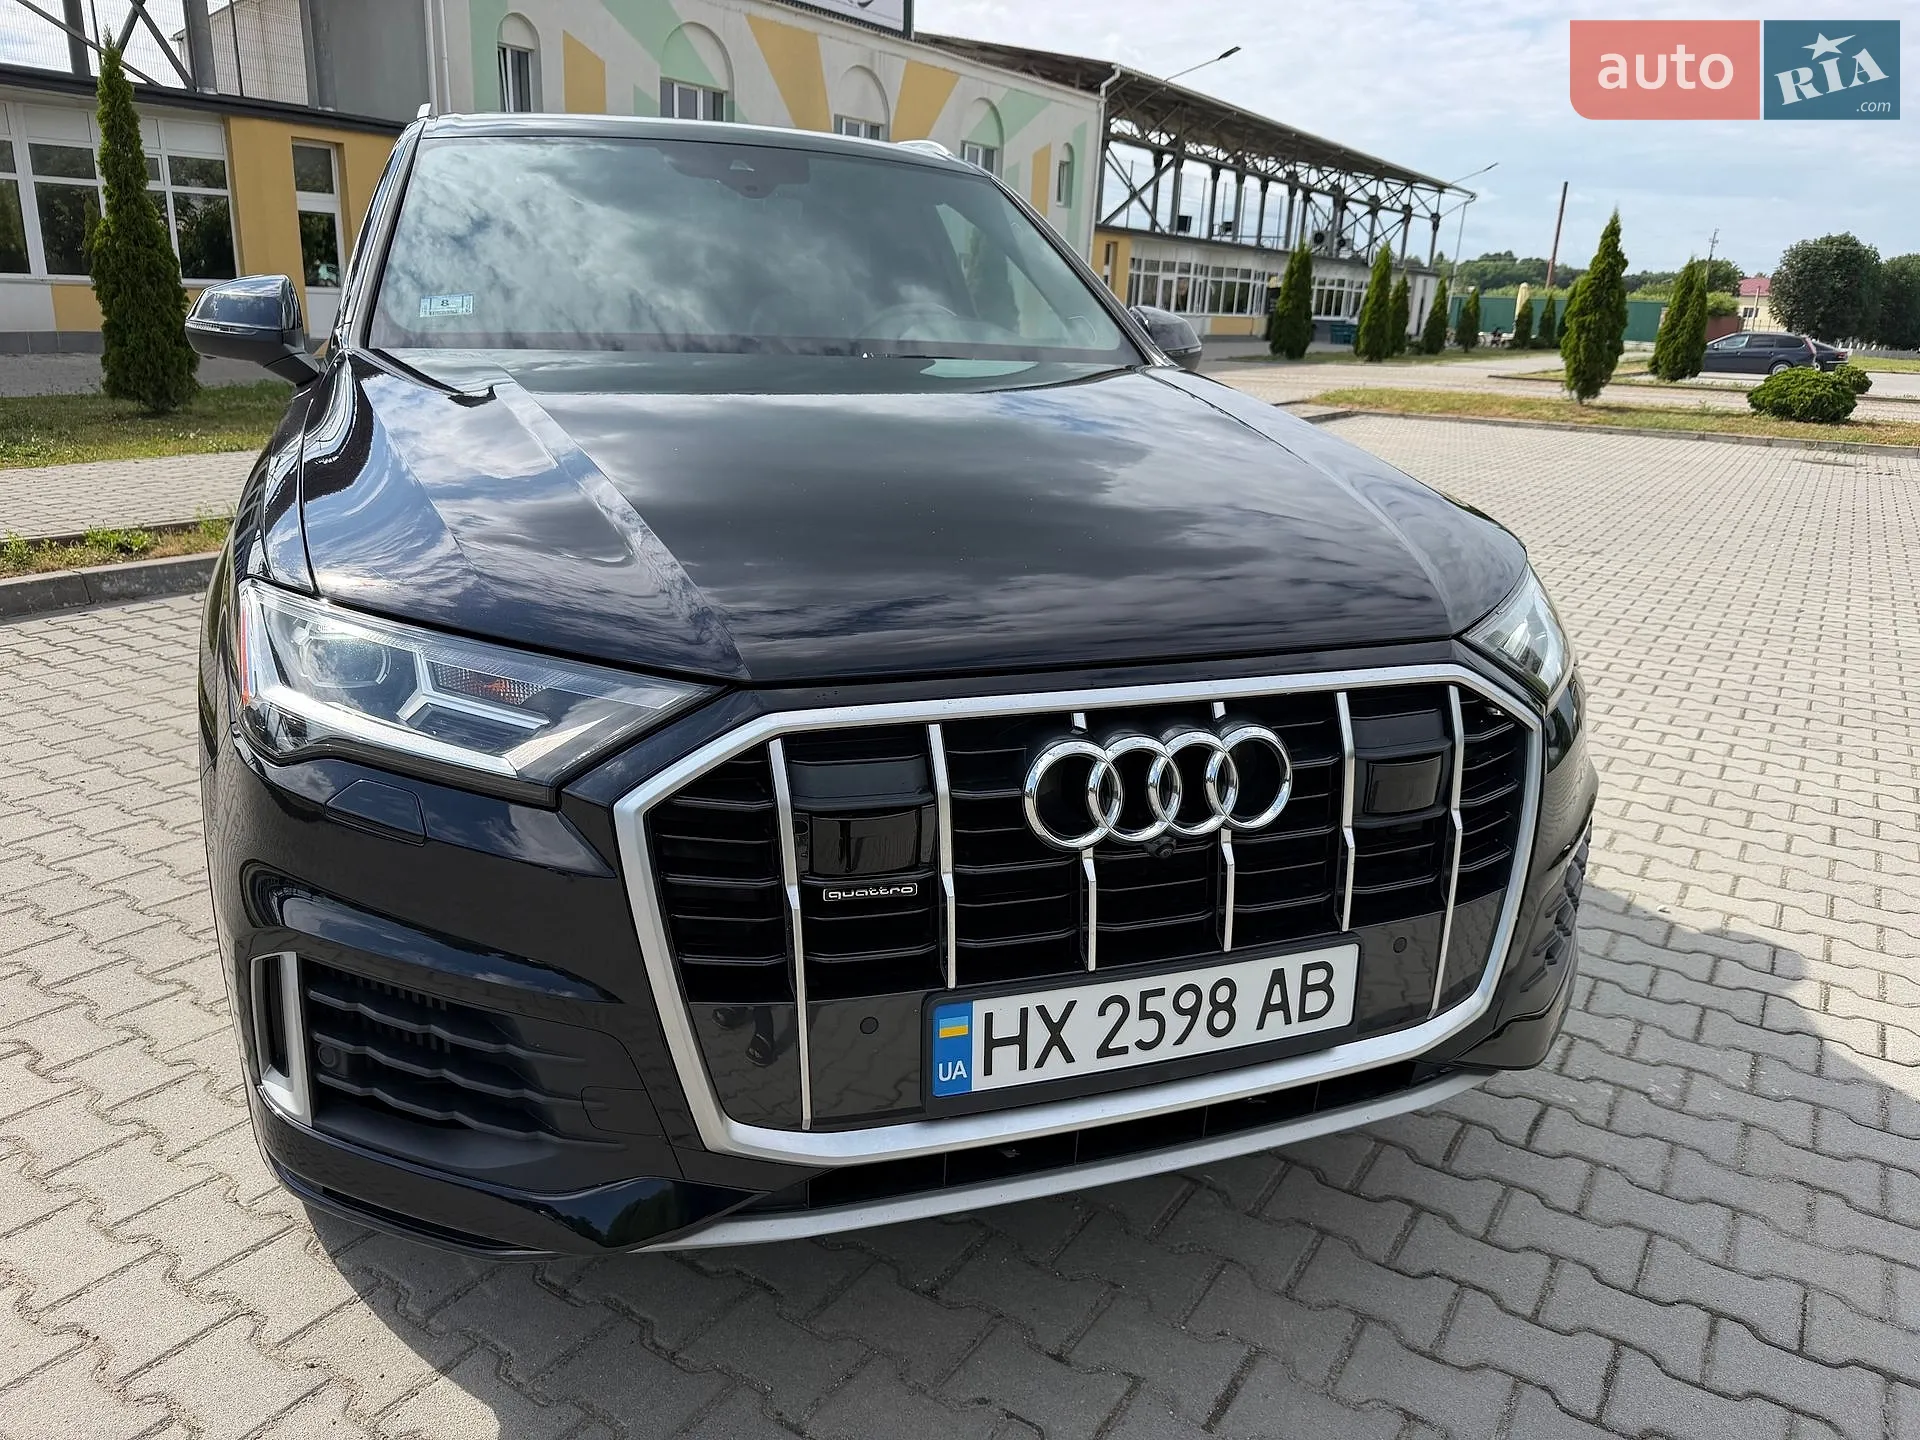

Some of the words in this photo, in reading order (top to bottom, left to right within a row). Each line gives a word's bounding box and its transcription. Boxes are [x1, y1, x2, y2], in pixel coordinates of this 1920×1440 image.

[828, 886, 914, 900] quattro
[983, 1000, 1077, 1077] HX
[1096, 977, 1237, 1059] 2598
[1255, 960, 1335, 1031] AB
[938, 1060, 968, 1081] UA
